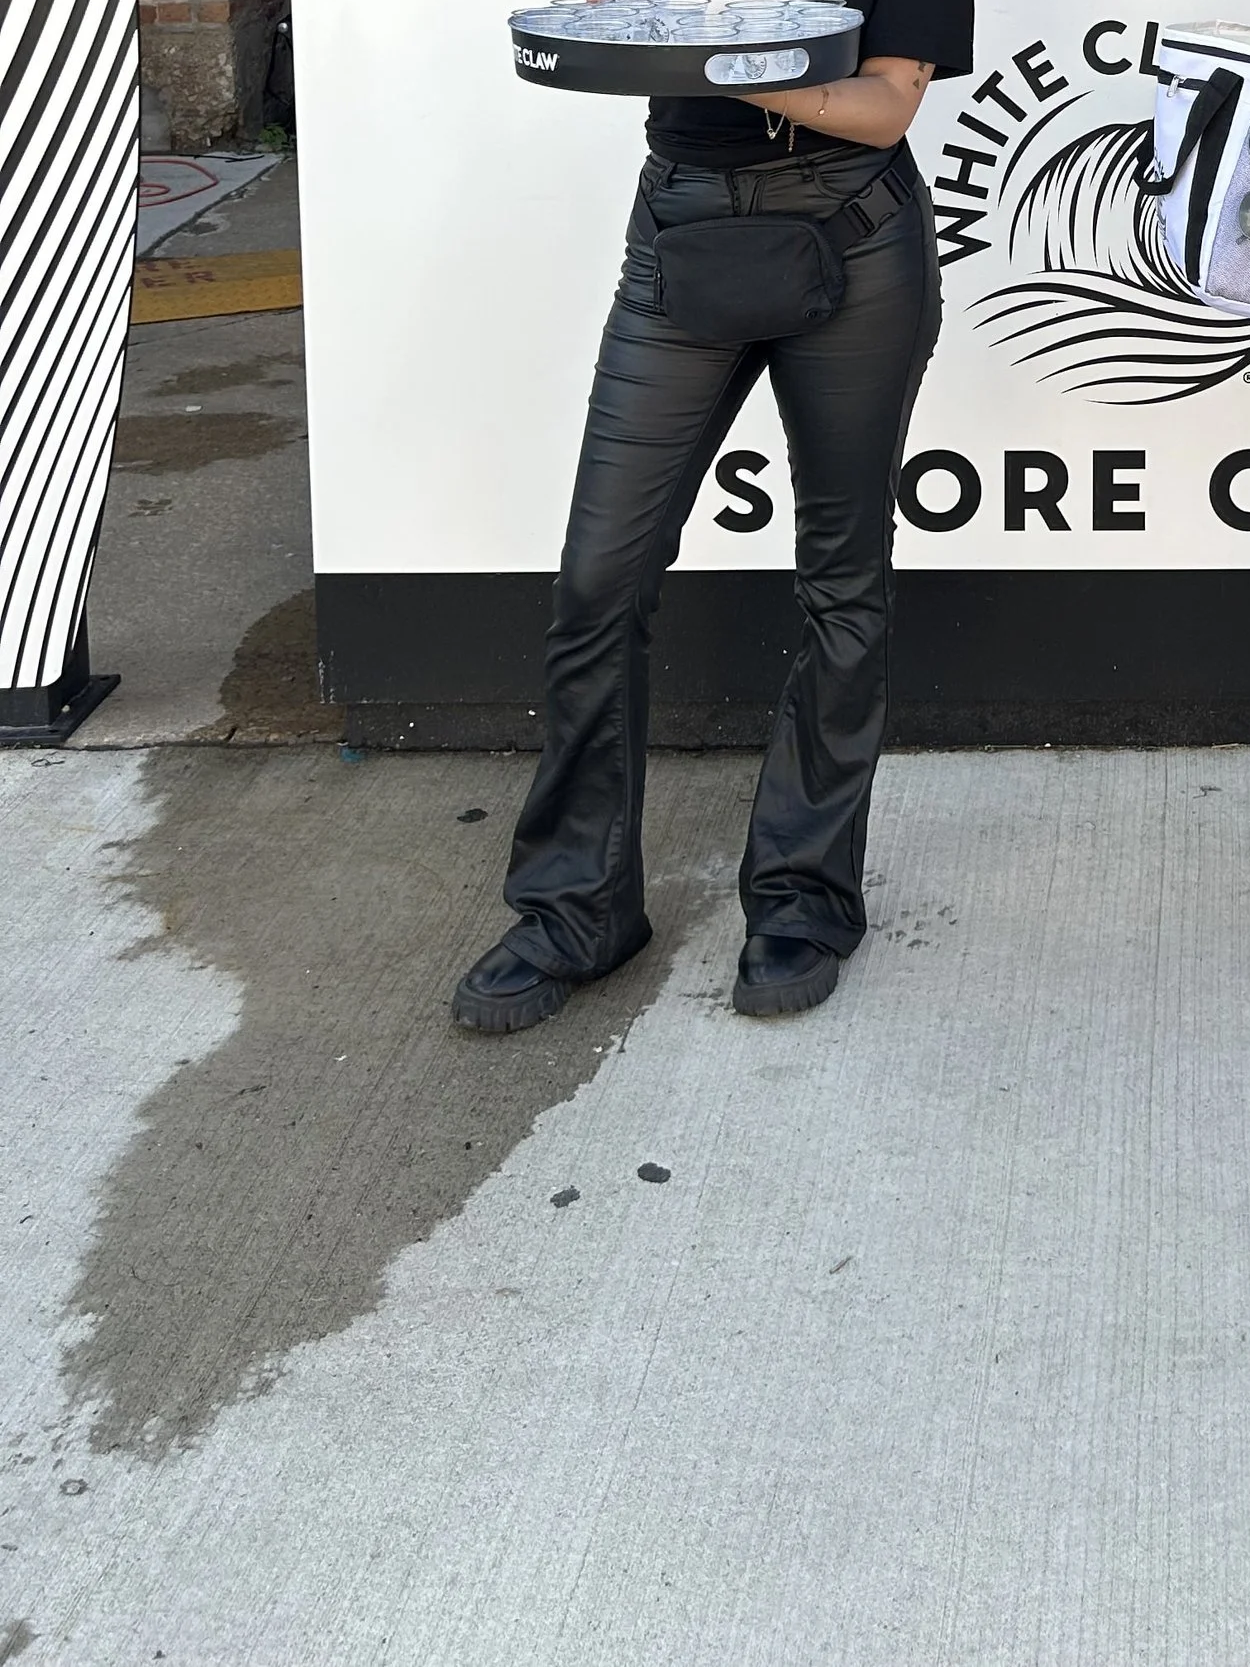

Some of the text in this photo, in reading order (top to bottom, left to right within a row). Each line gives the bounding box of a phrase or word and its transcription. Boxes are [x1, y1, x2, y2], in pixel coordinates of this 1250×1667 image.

[523, 47, 558, 71] CLAW
[933, 20, 1160, 268] WHITE CL
[713, 449, 1147, 533] SORE
